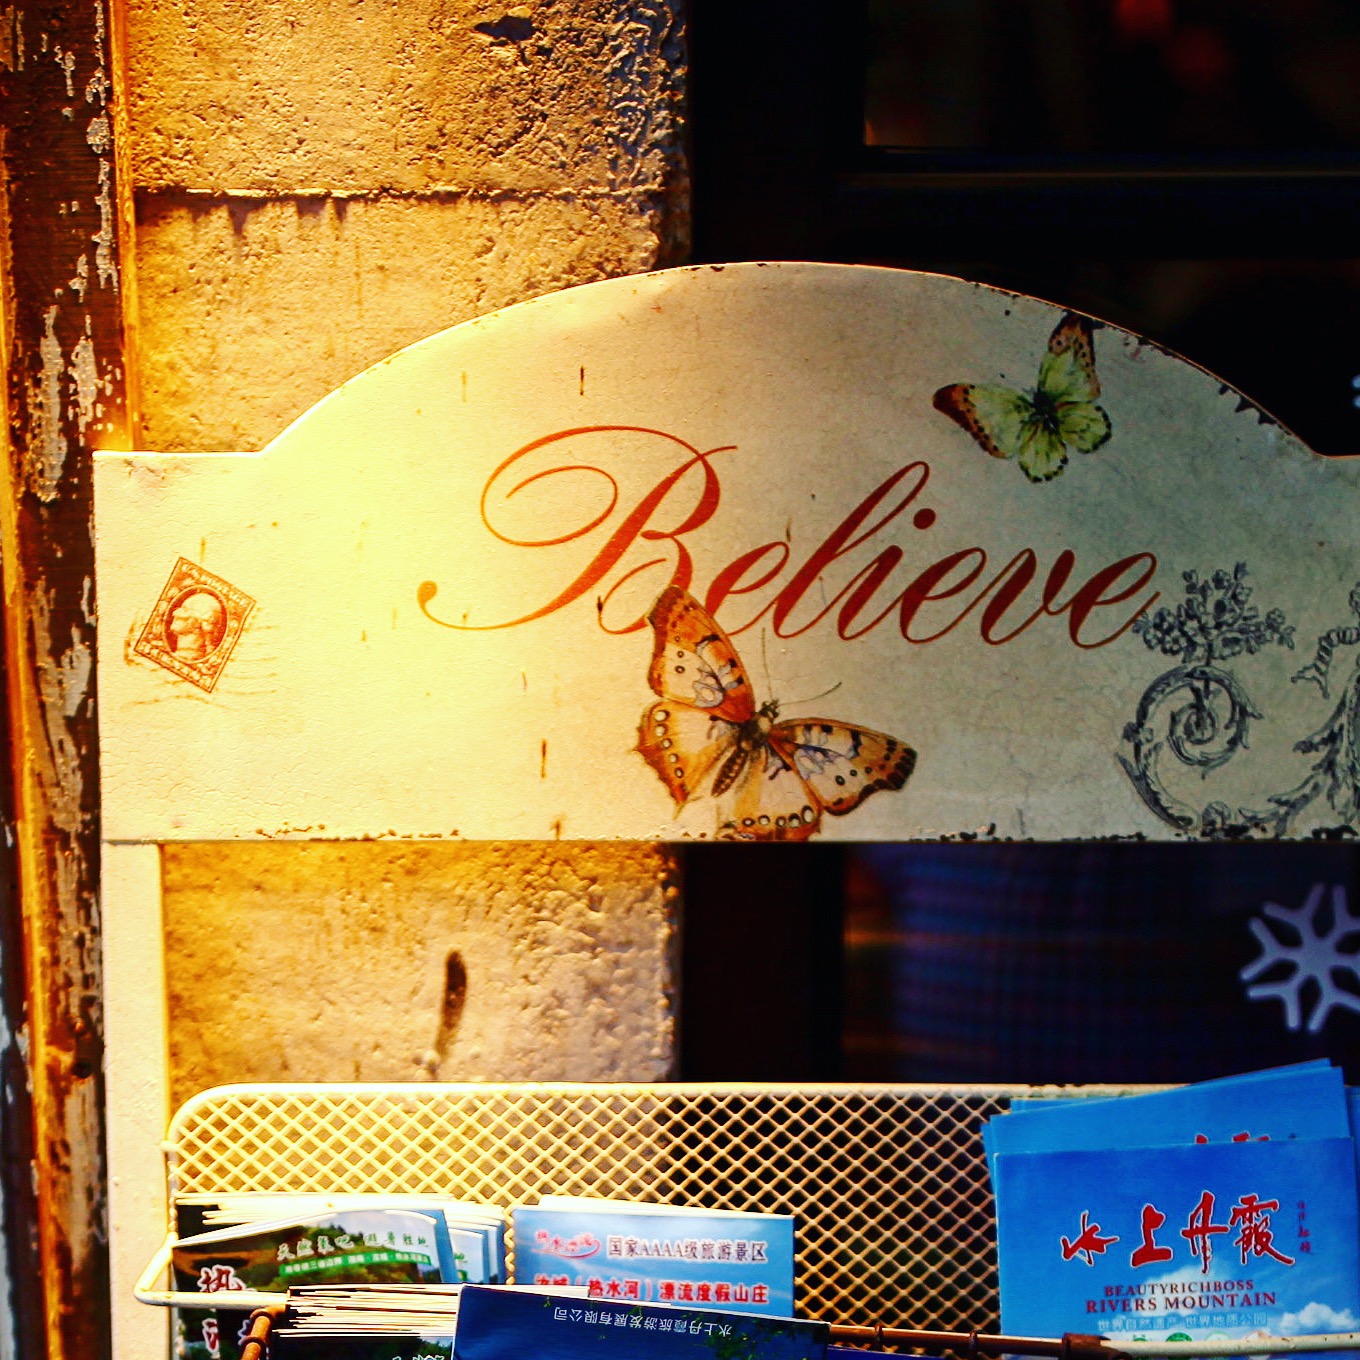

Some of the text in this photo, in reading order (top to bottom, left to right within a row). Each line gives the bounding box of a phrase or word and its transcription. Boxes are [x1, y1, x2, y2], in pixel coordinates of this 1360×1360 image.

[418, 425, 1160, 650] Believe
[1061, 1190, 1295, 1274] 水上丹霞
[607, 1235, 768, 1263] 国家AAAA级旅游景区
[1104, 1279, 1254, 1297] BEAUTYRICHBOSS
[1086, 1292, 1277, 1314] RIVERS MOUNTAIN
